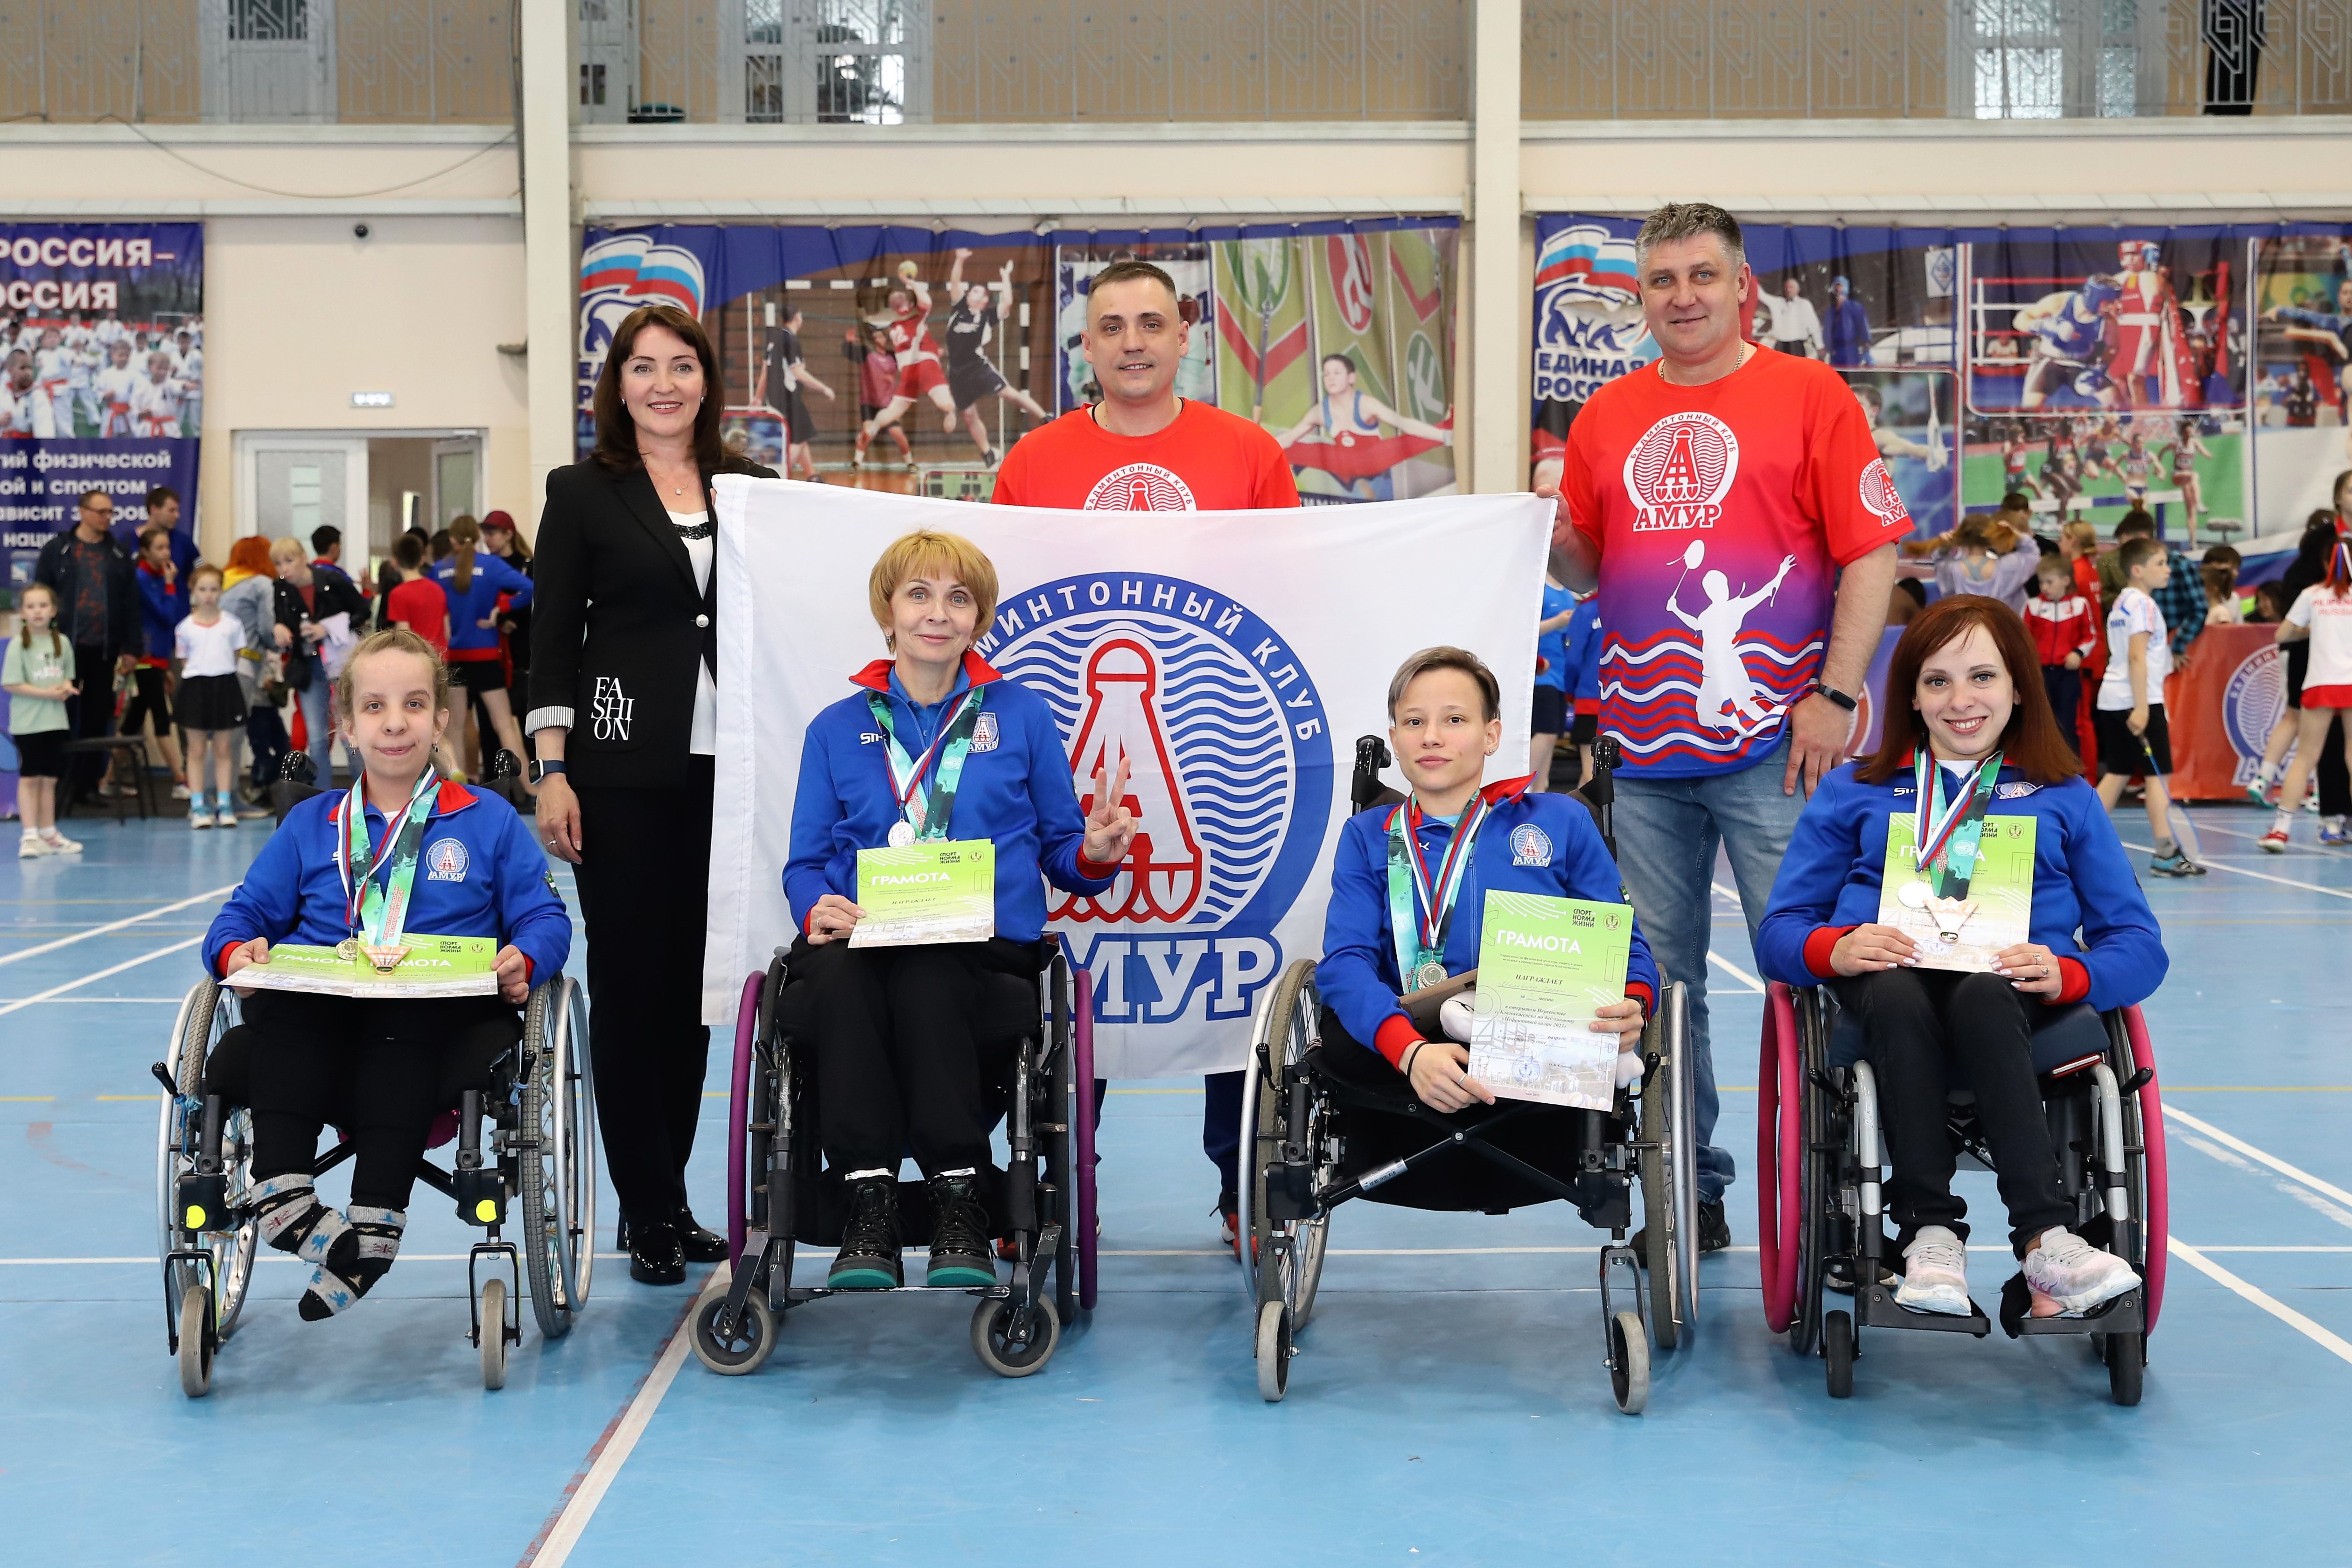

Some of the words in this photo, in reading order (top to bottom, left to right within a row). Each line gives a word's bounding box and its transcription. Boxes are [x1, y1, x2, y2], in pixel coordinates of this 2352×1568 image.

[0, 280, 118, 310] ССИЯ
[1631, 414, 1719, 459] БАДМИНТОННЫЙ
[1721, 428, 1736, 452] КЛУБ
[0, 450, 28, 468] ий
[33, 448, 172, 473] физической
[1086, 465, 1170, 510] БАДМИНТОННЫЙ
[1173, 480, 1193, 504] КЛУБ
[0, 506, 64, 522] висит
[1634, 504, 1721, 531] АМУР
[974, 580, 1245, 658] МИНТОННЫЙ
[1251, 637, 1322, 741] КЛУБ
[968, 741, 997, 752] АМУР
[1515, 856, 1548, 866] АМУР
[430, 871, 463, 881] АМУР
[872, 872, 951, 886] ГРАМОТА
[1497, 929, 1582, 955] ГРАМОТА
[275, 954, 354, 966] ГРАМОТА
[1044, 937, 1275, 1017] МУР
[1515, 974, 1564, 985] НАГРАЖДАЕТ
